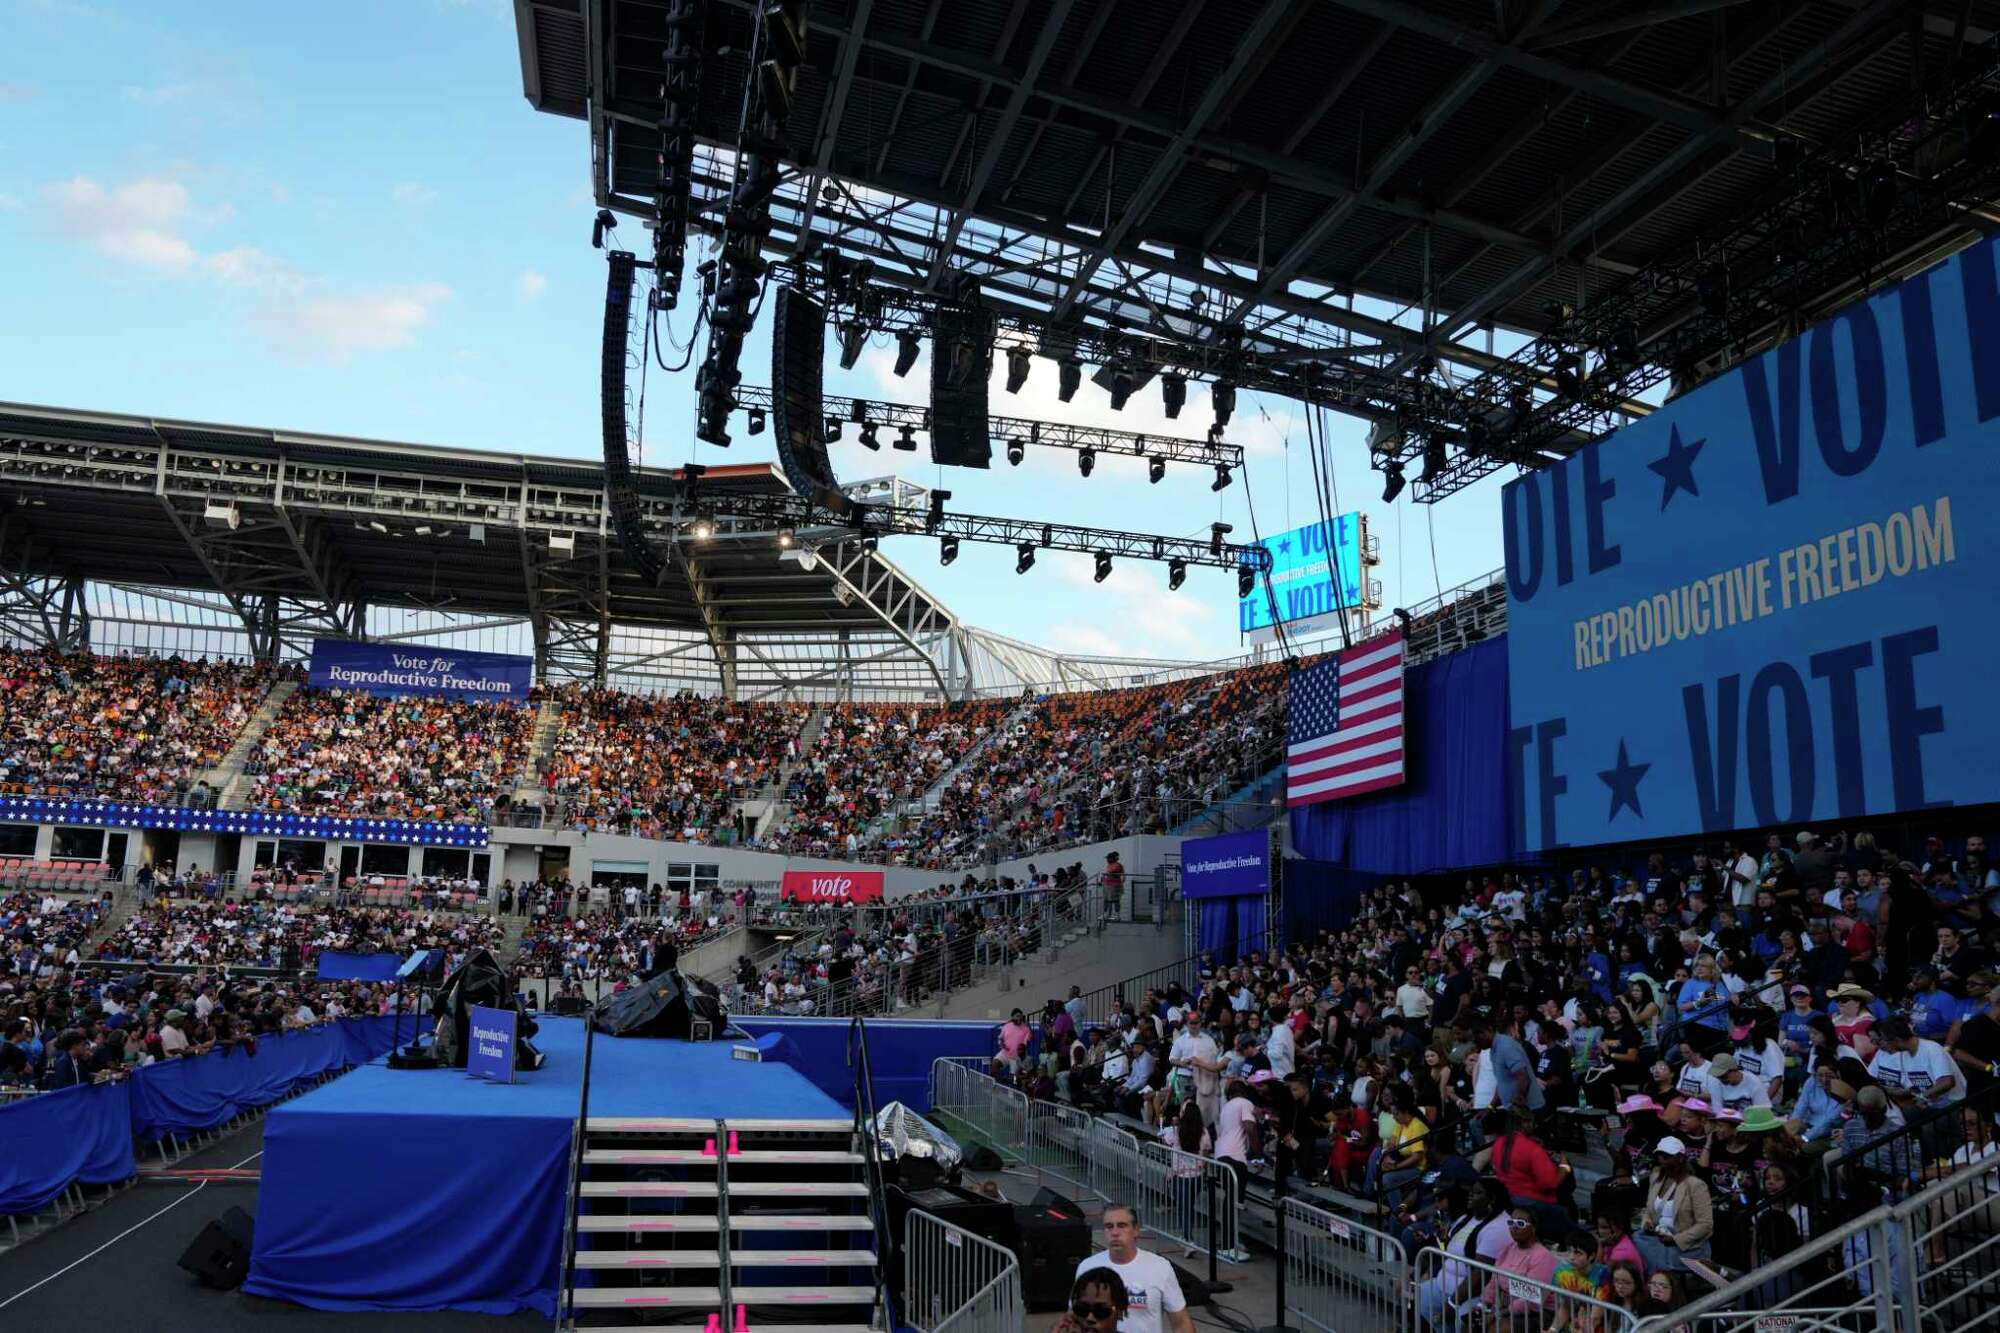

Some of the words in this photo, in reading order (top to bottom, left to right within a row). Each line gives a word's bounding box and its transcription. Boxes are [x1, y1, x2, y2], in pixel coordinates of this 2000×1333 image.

[1574, 558, 1772, 671] REPRODUCTIVE
[1779, 496, 1955, 610] FREEDOM
[392, 653, 428, 669] Vote
[428, 657, 455, 673] for
[329, 665, 438, 688] Reproductive
[441, 674, 511, 692] Freedom
[1682, 626, 1954, 835] VOTE
[1237, 856, 1261, 867] Freedom
[811, 876, 852, 896] vote
[473, 1026, 509, 1043] Reproductive
[479, 1043, 503, 1058] Freedom
